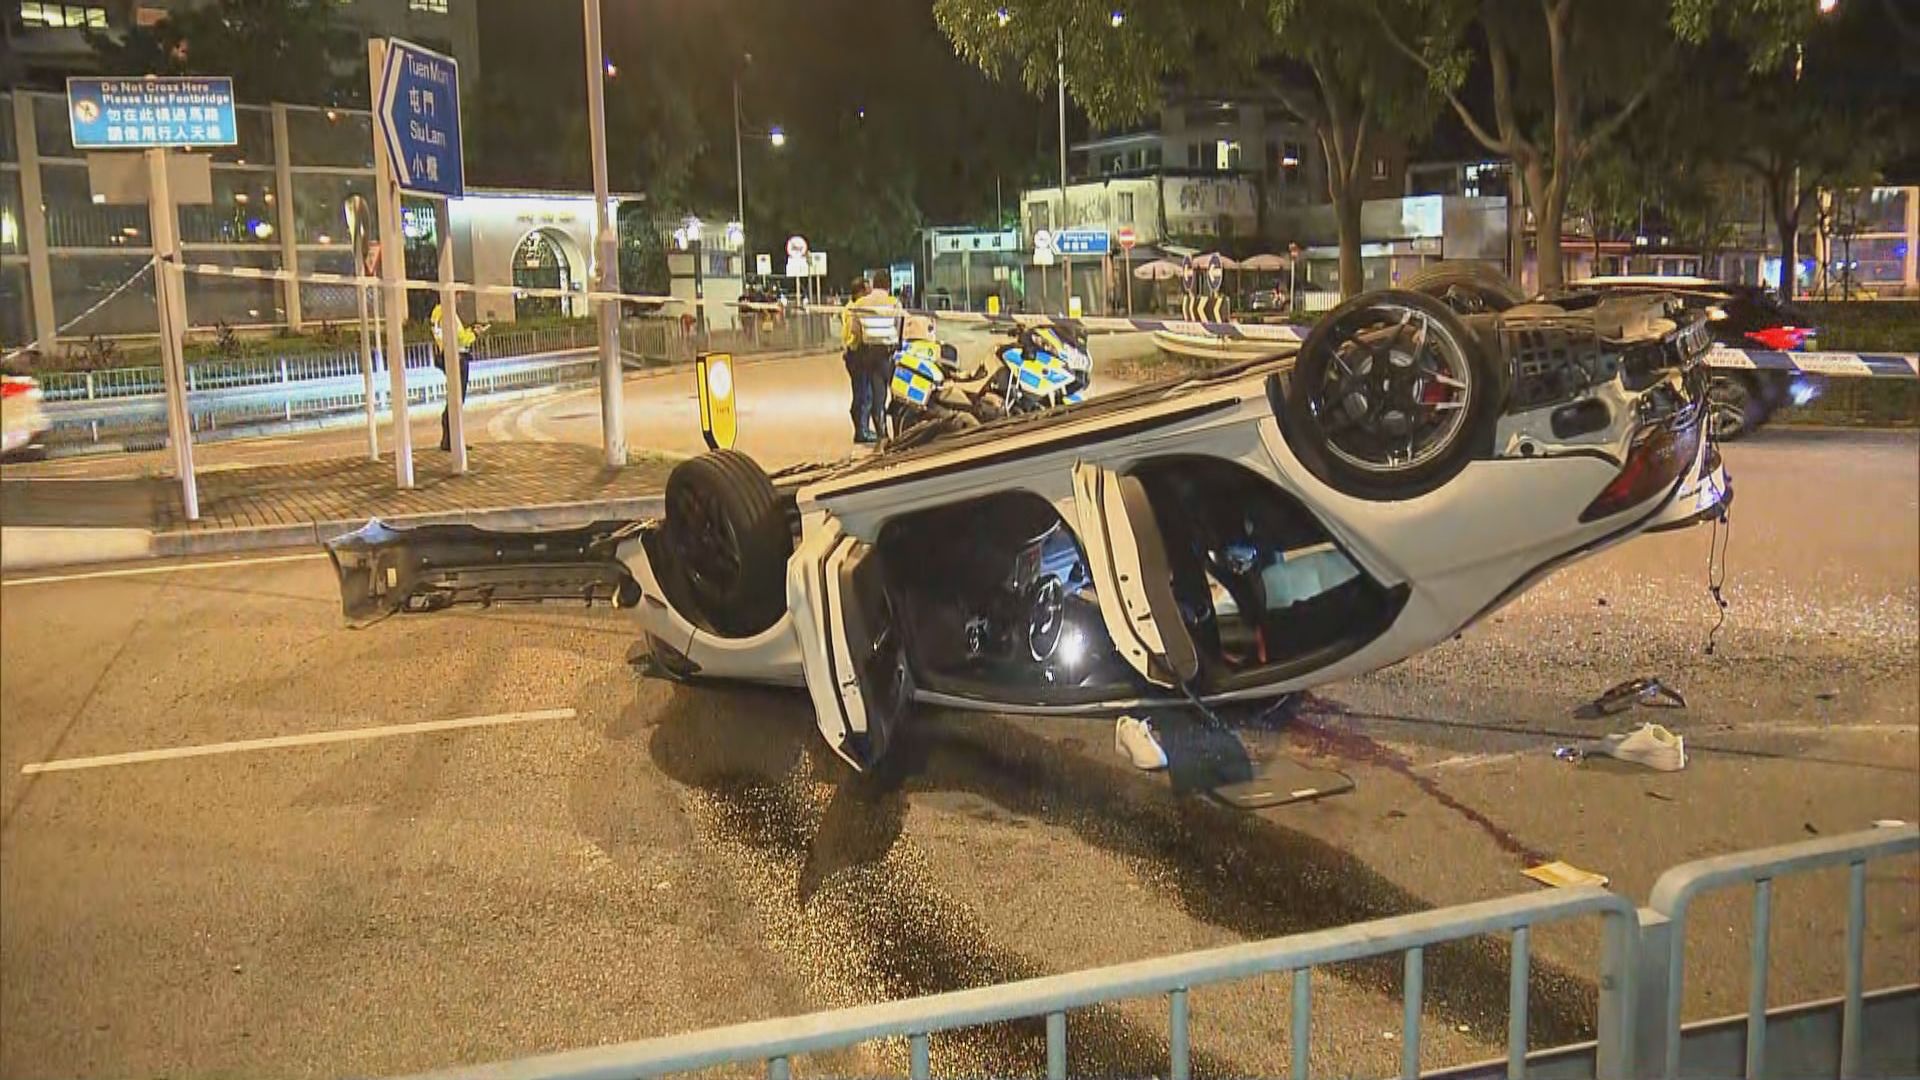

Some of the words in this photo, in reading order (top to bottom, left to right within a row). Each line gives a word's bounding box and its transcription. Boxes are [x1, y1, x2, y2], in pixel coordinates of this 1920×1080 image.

[406, 53, 430, 79] Tuen
[101, 82, 118, 93] Do
[120, 82, 143, 93] Not
[146, 82, 179, 93] Cross
[182, 82, 209, 93] Here
[102, 94, 141, 105] Please
[144, 94, 166, 105] Use
[169, 94, 230, 106] Footbridge
[408, 86, 435, 117] 屯門
[410, 119, 425, 142] Siu
[425, 122, 447, 148] Lam
